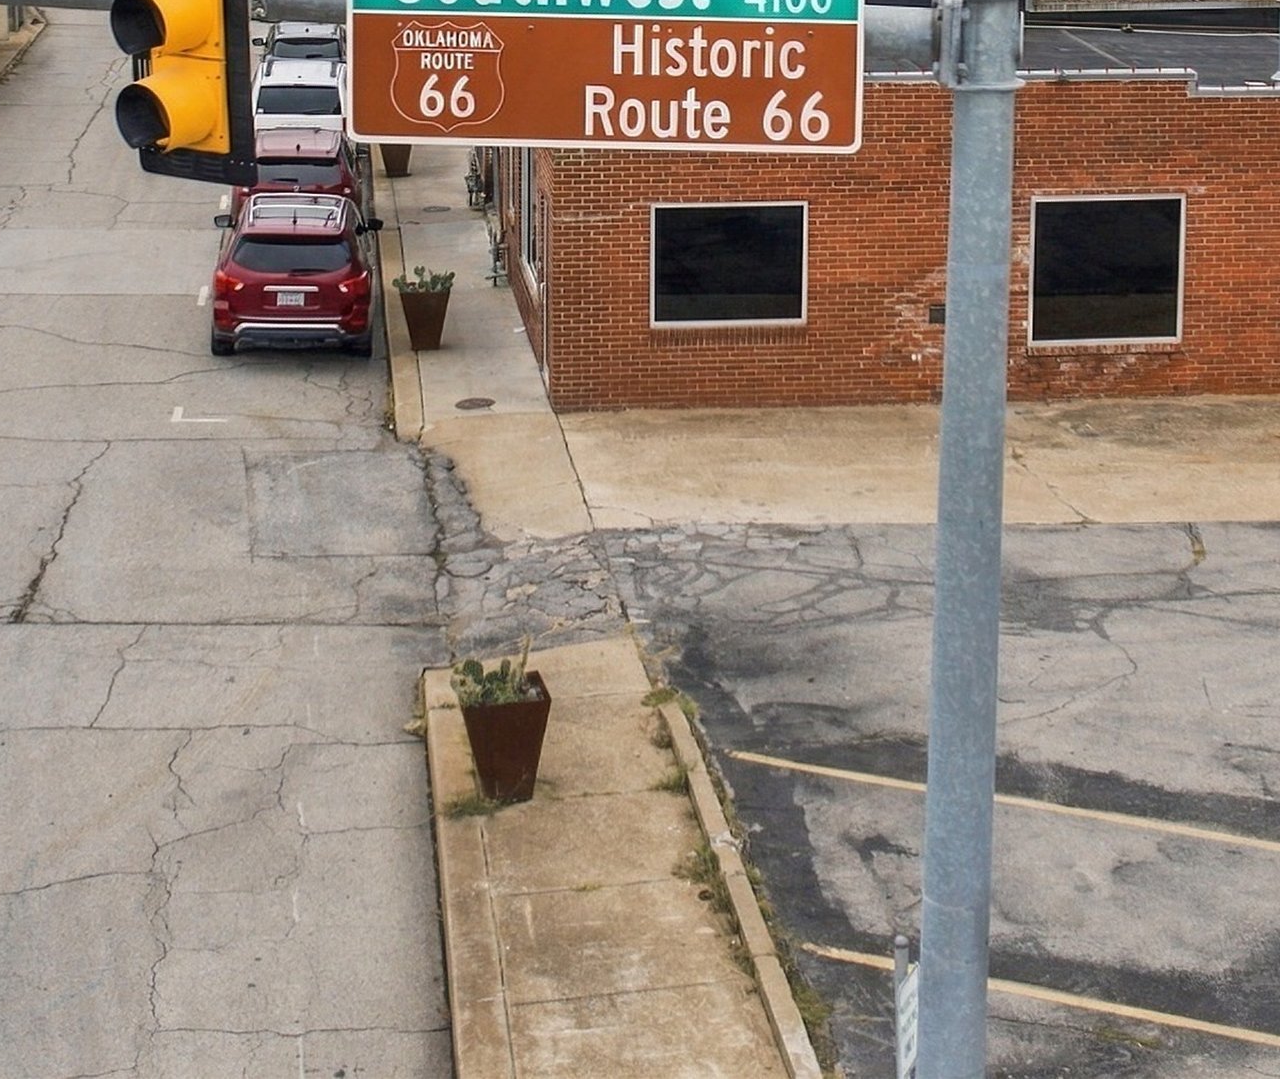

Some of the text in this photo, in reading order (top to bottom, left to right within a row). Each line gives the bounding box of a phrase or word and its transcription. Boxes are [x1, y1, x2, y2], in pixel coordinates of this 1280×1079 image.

[402, 29, 494, 49] OKLAHOMA
[420, 52, 474, 70] ROUTE
[613, 24, 806, 80] Historic
[419, 74, 475, 118] 66
[584, 85, 830, 142] Route 66
